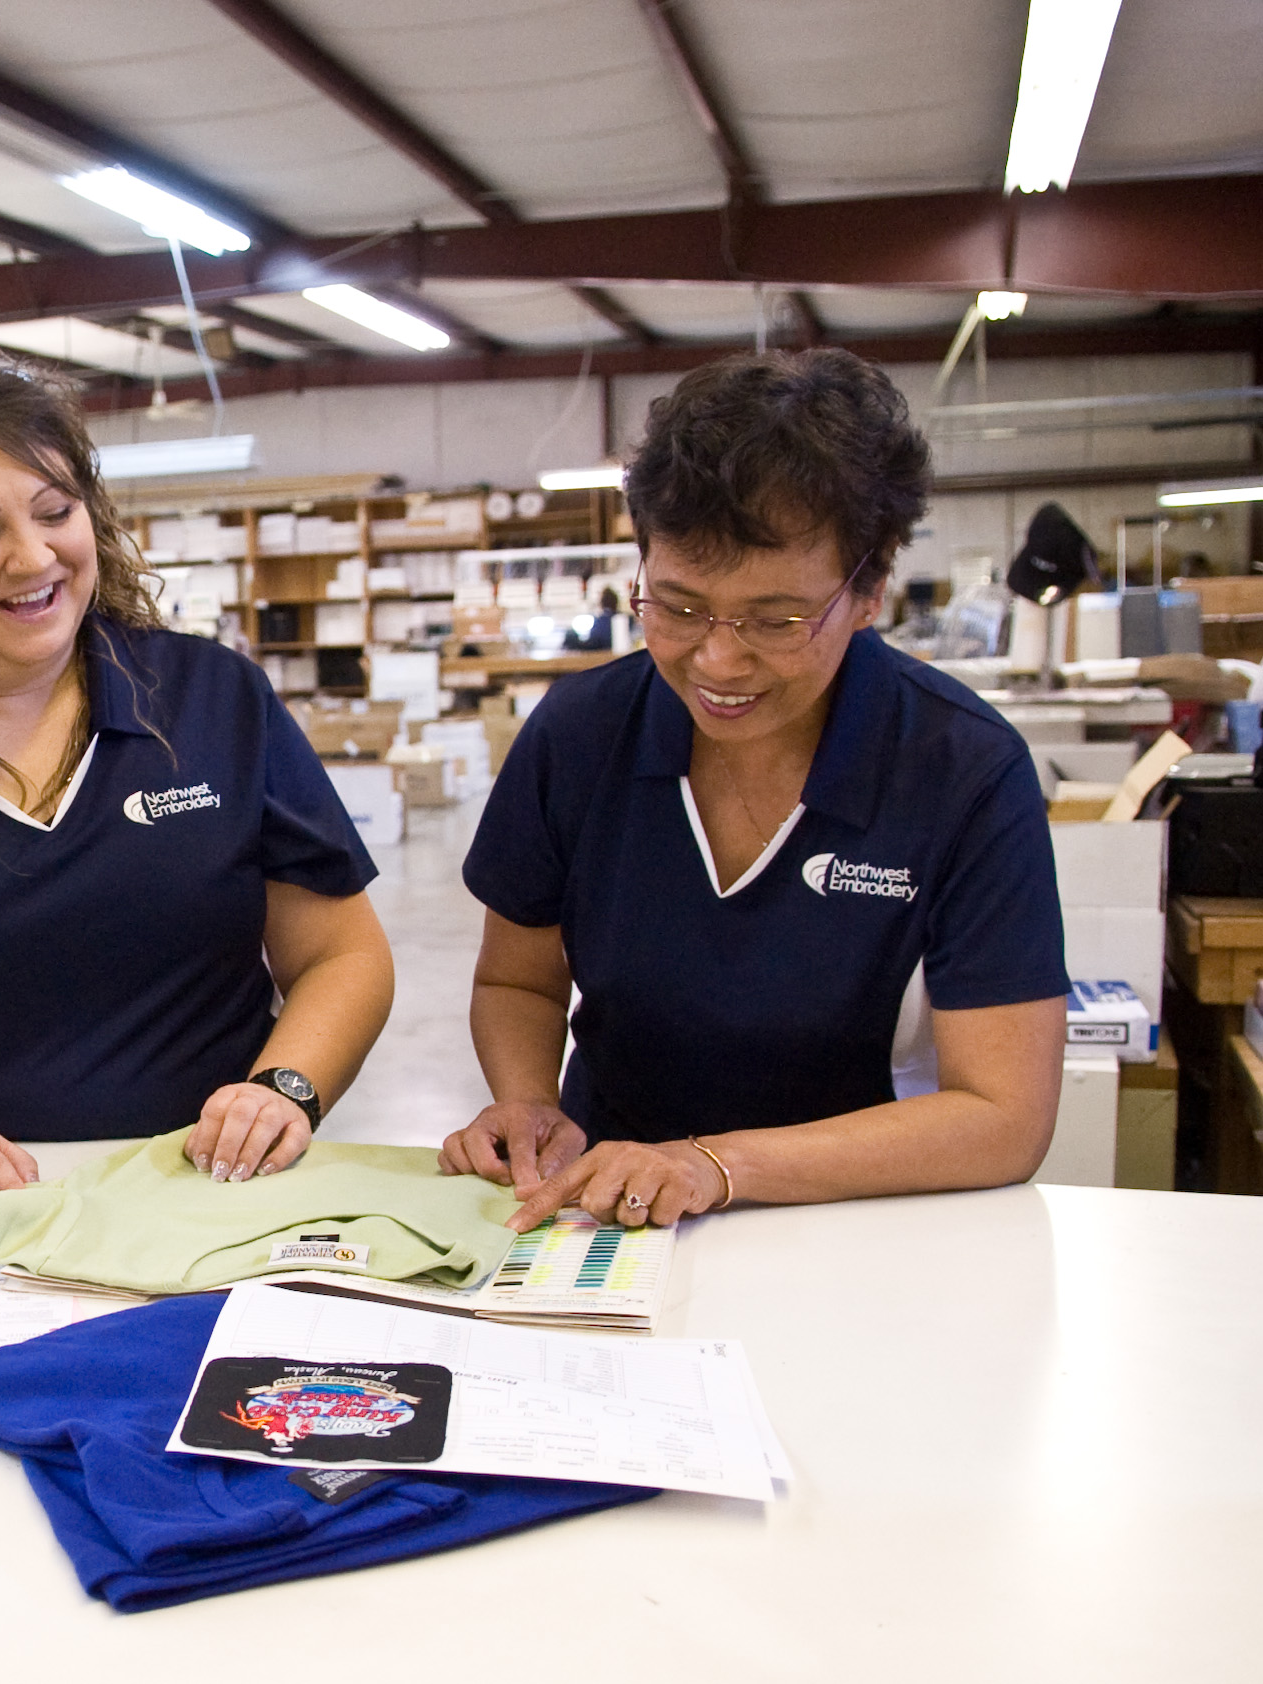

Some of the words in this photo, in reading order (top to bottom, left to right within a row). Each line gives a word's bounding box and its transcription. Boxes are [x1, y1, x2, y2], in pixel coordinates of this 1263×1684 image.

[144, 782, 212, 806] Northwest
[150, 793, 221, 818] Embroidery
[831, 858, 911, 883] Northwest
[829, 874, 919, 903] Embroidery
[283, 1365, 335, 1377] Alaska
[277, 1392, 379, 1408] Shack
[247, 1405, 321, 1419] Crab
[326, 1405, 405, 1423] King
